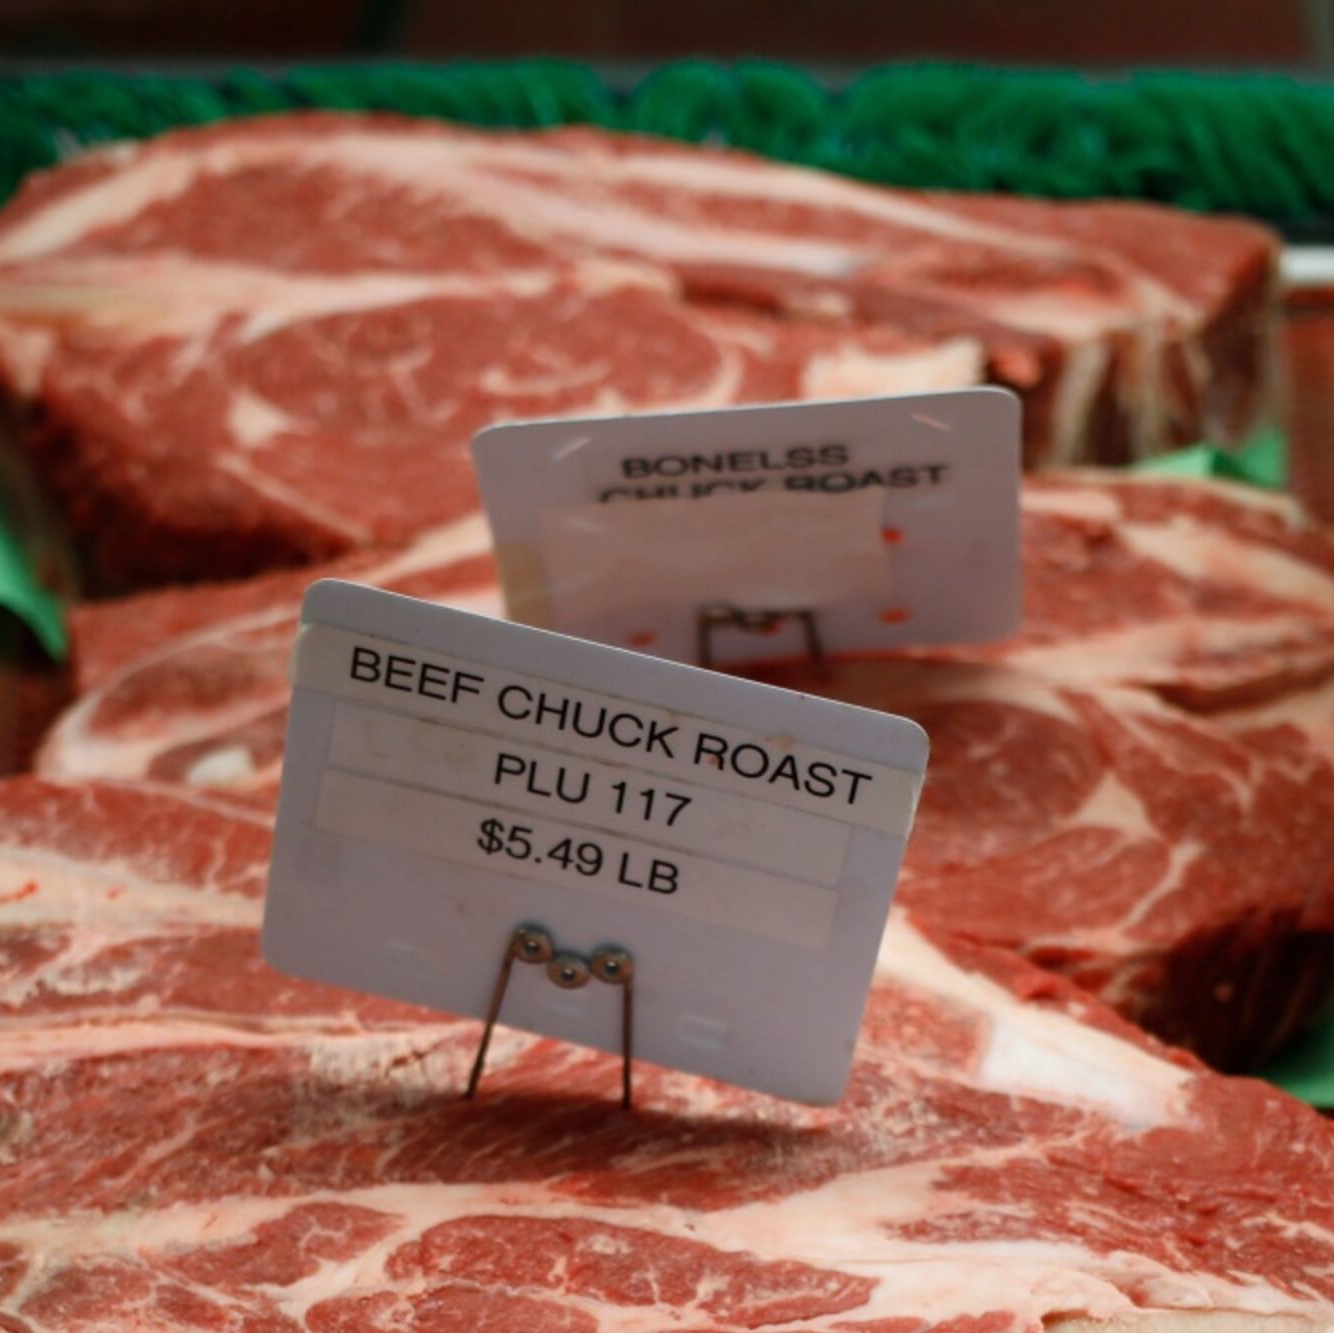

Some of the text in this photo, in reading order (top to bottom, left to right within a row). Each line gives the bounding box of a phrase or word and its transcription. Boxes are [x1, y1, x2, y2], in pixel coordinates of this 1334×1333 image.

[621, 445, 850, 479] BONELSS
[783, 462, 951, 494] ROAST
[348, 645, 873, 805] BEEF CHUCK ROAST
[493, 752, 693, 828] PLU 117
[475, 817, 681, 896] $5.49 LB
